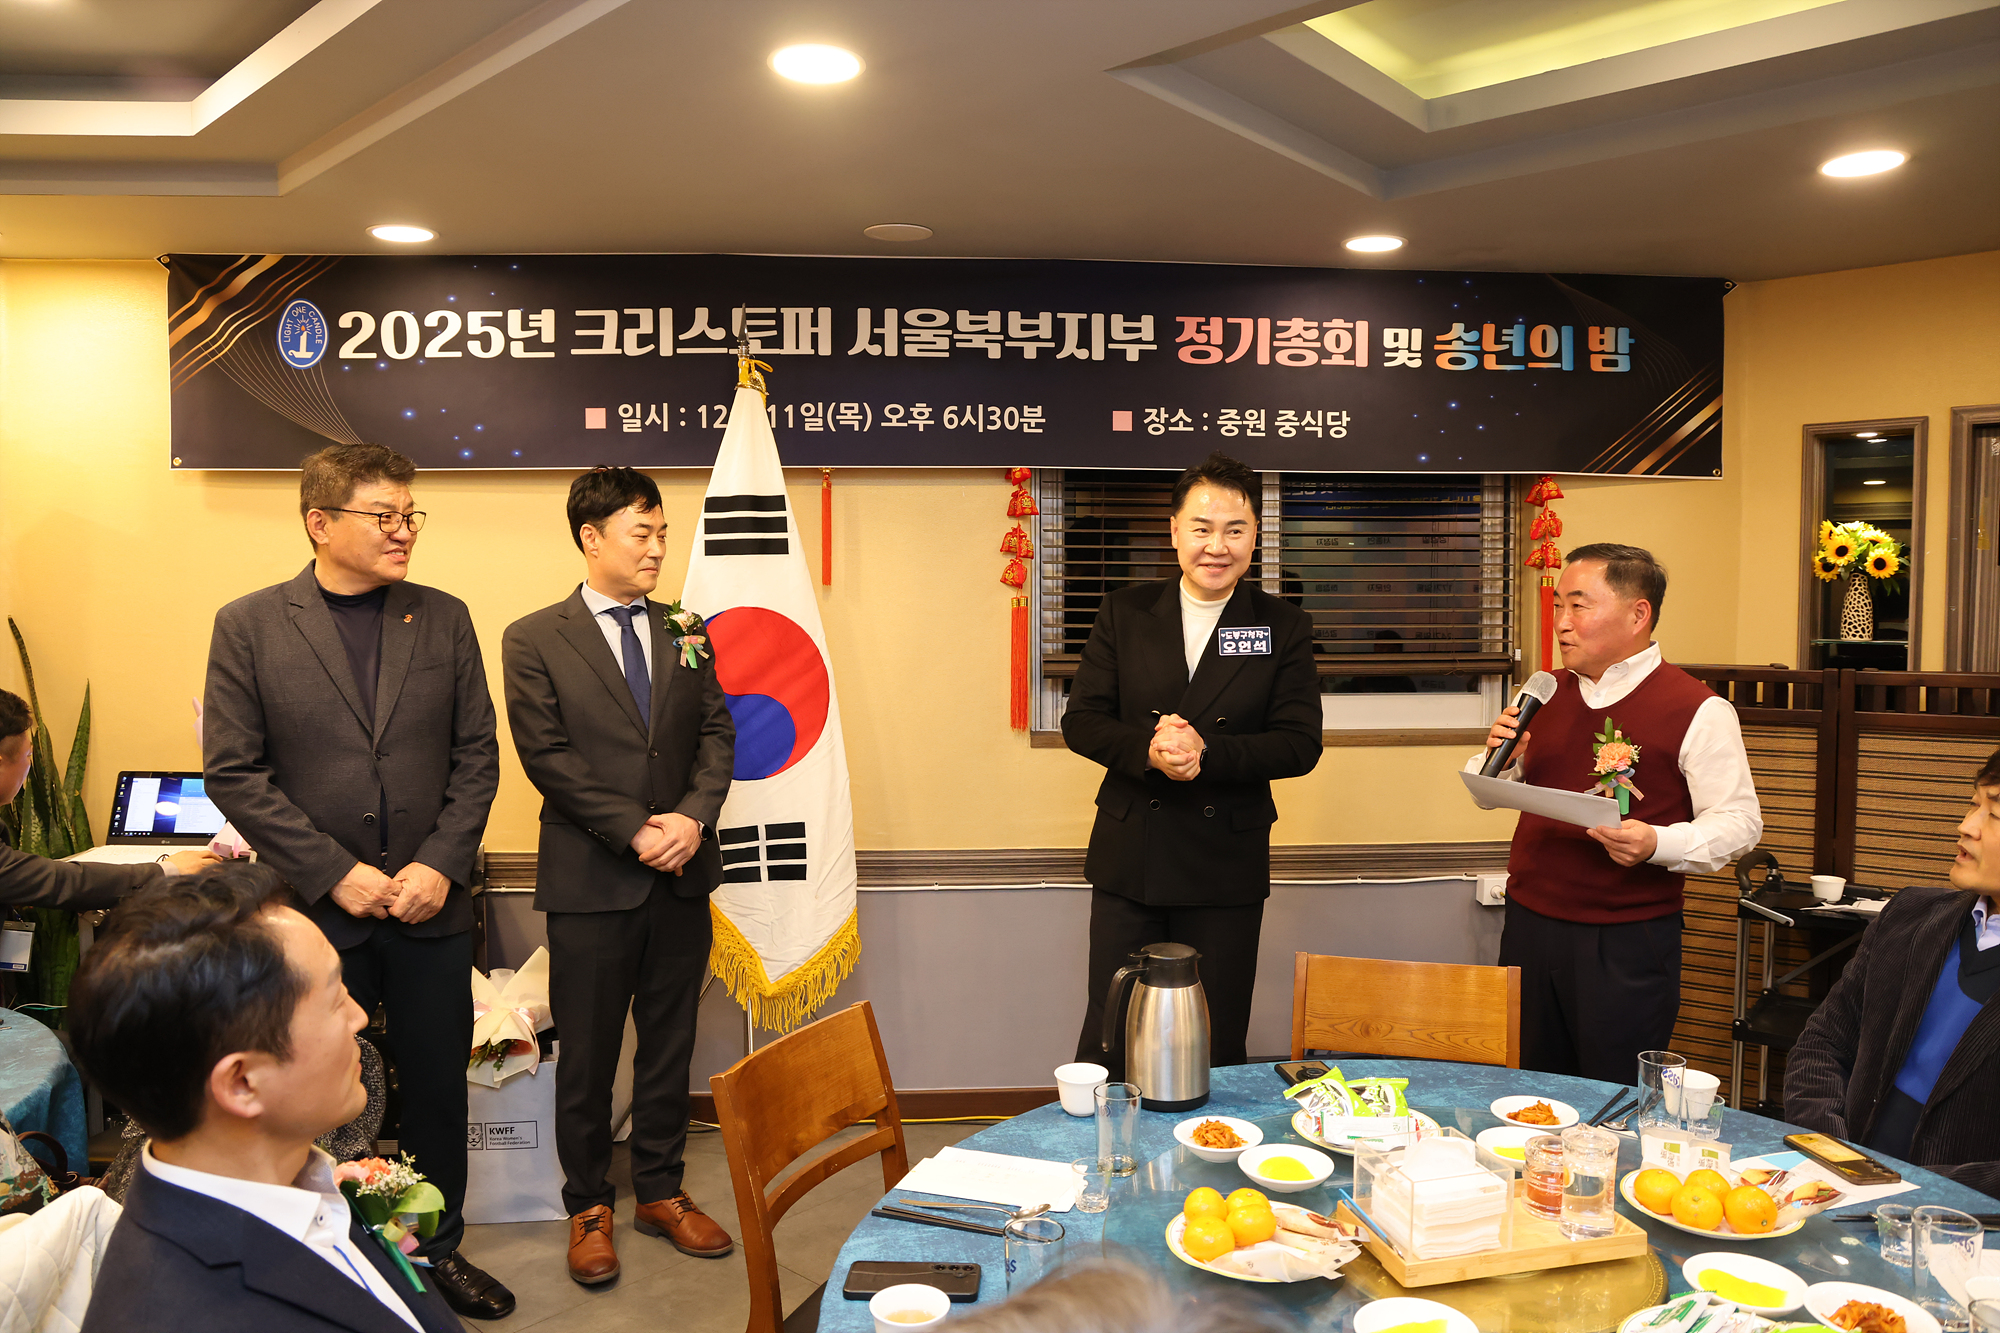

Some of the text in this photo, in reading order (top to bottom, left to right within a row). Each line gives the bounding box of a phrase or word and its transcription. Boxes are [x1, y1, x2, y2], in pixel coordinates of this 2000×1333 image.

[284, 306, 323, 344] LIGHT ONE CANDLE
[338, 305, 1635, 373] 2025년 크리스토퍼 서울북부지부 정기총회 및 송년의 밤
[617, 401, 1046, 434] 일시 : 12 11일(목) 오후 6시30분
[1143, 406, 1351, 439] 장소 : 중원 중식당
[1223, 640, 1267, 653] 오언석
[489, 1126, 515, 1135] KWFF
